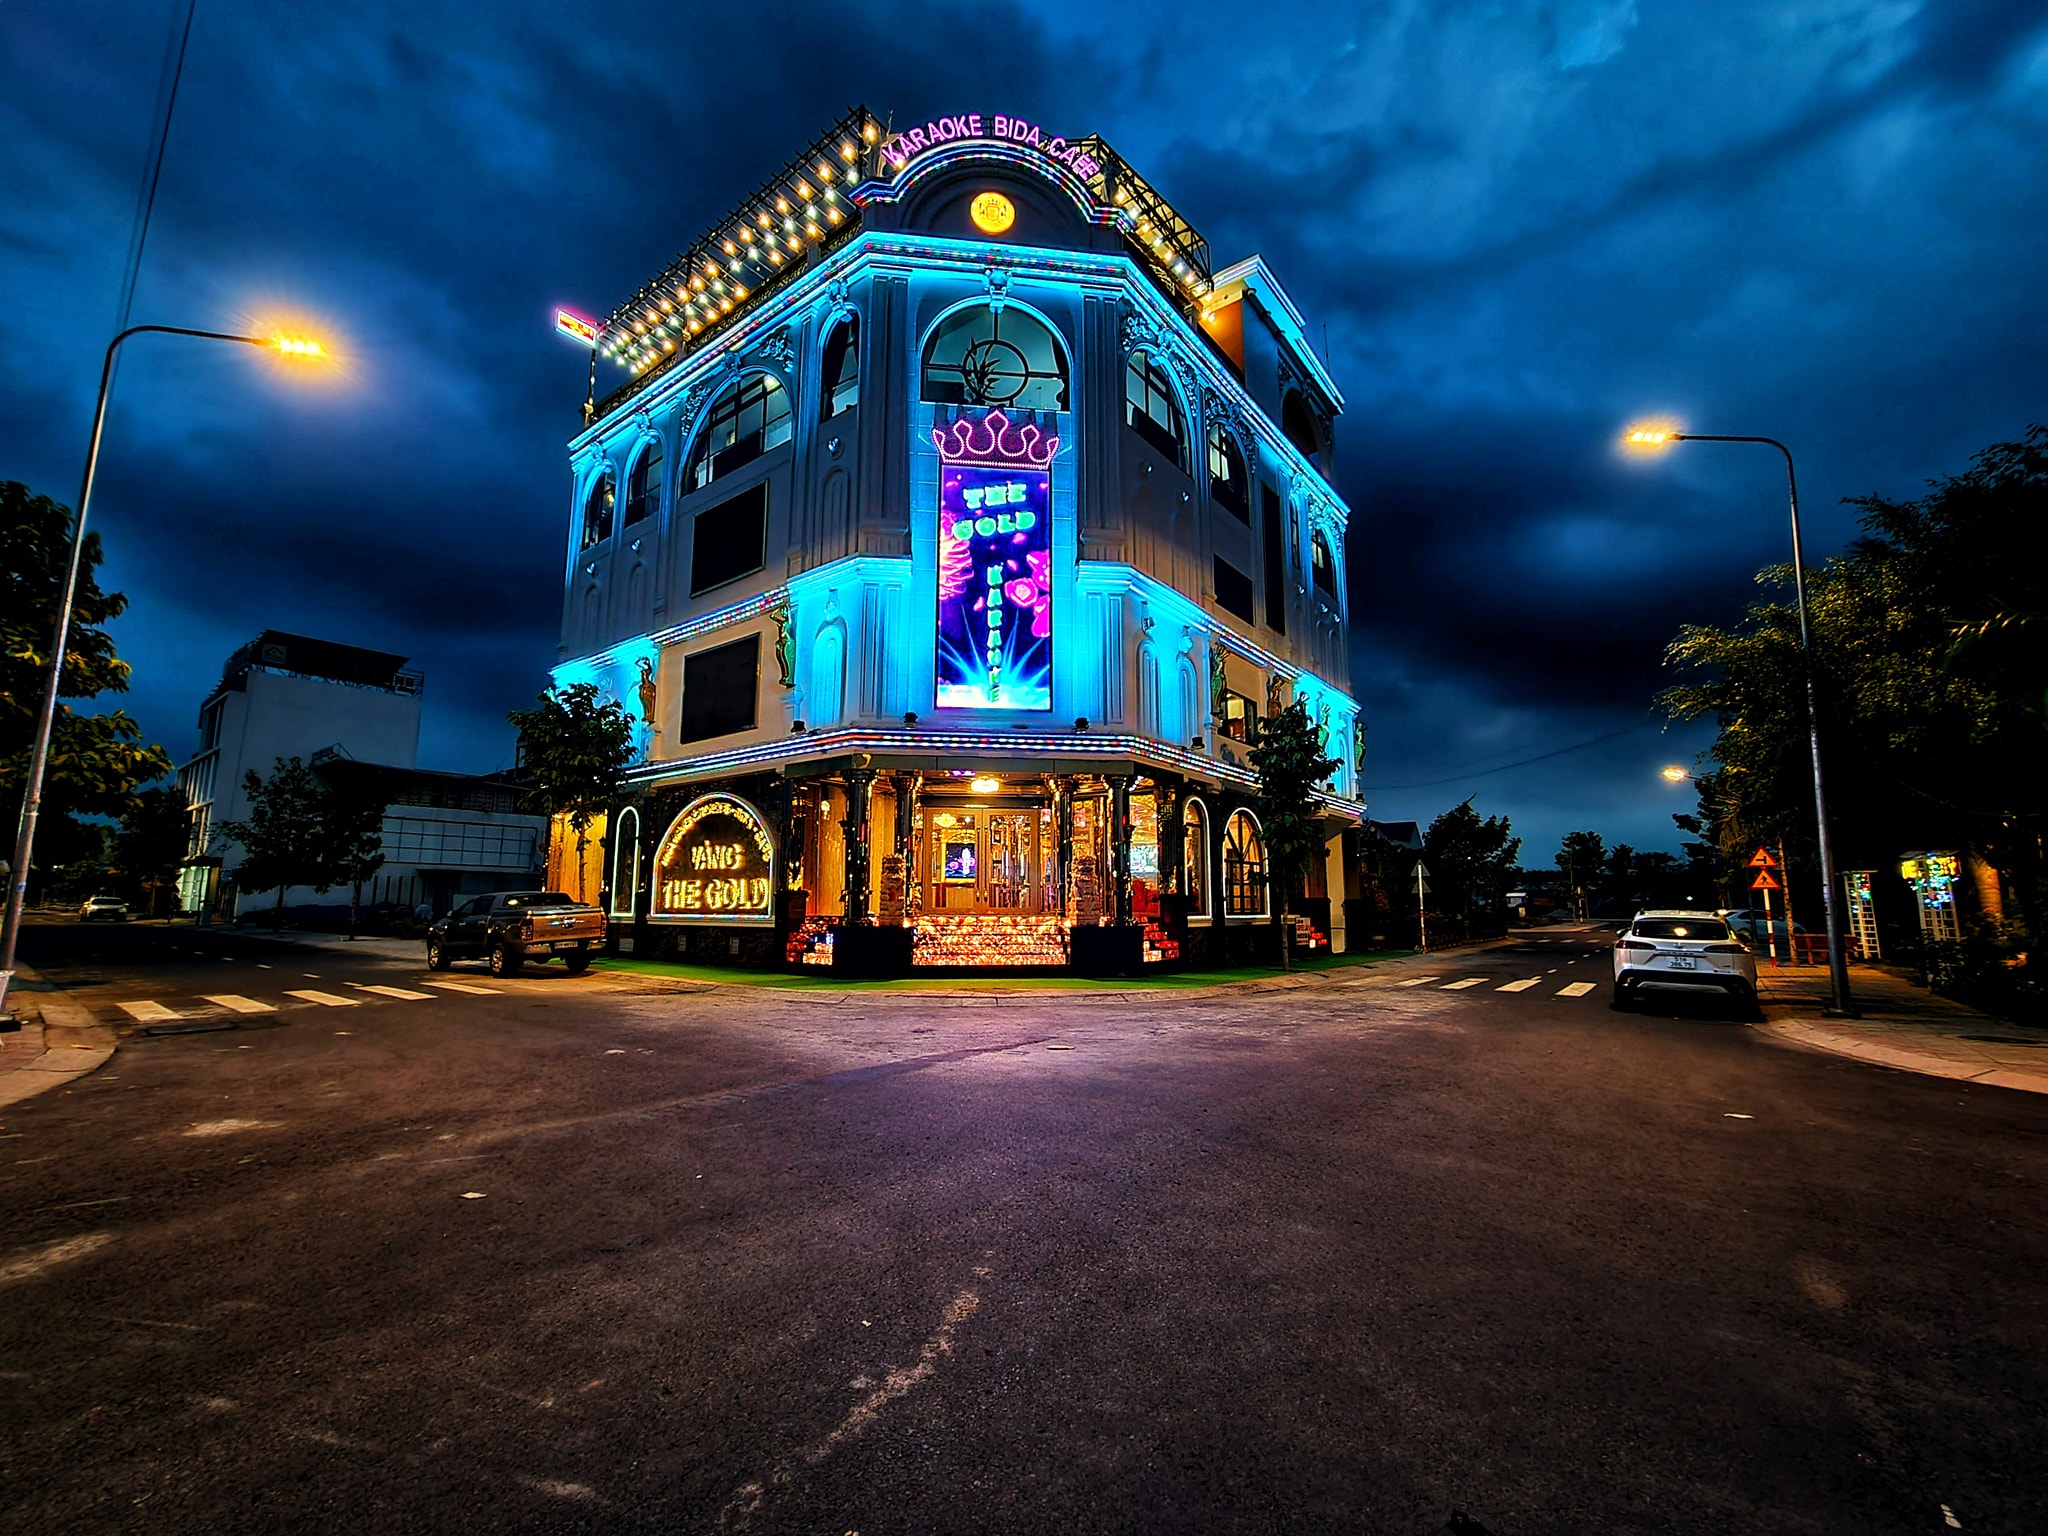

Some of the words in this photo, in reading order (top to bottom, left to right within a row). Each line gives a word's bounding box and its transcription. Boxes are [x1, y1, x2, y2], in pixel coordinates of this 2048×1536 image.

[881, 113, 984, 167] KARAOKE
[993, 113, 1041, 148] BIDA
[1049, 137, 1102, 181] CAFE
[963, 483, 1027, 509] THE
[951, 510, 1036, 541] GOLD
[986, 564, 1003, 703] KARAOKE
[662, 878, 702, 910] THE
[704, 877, 769, 910] GOLD
